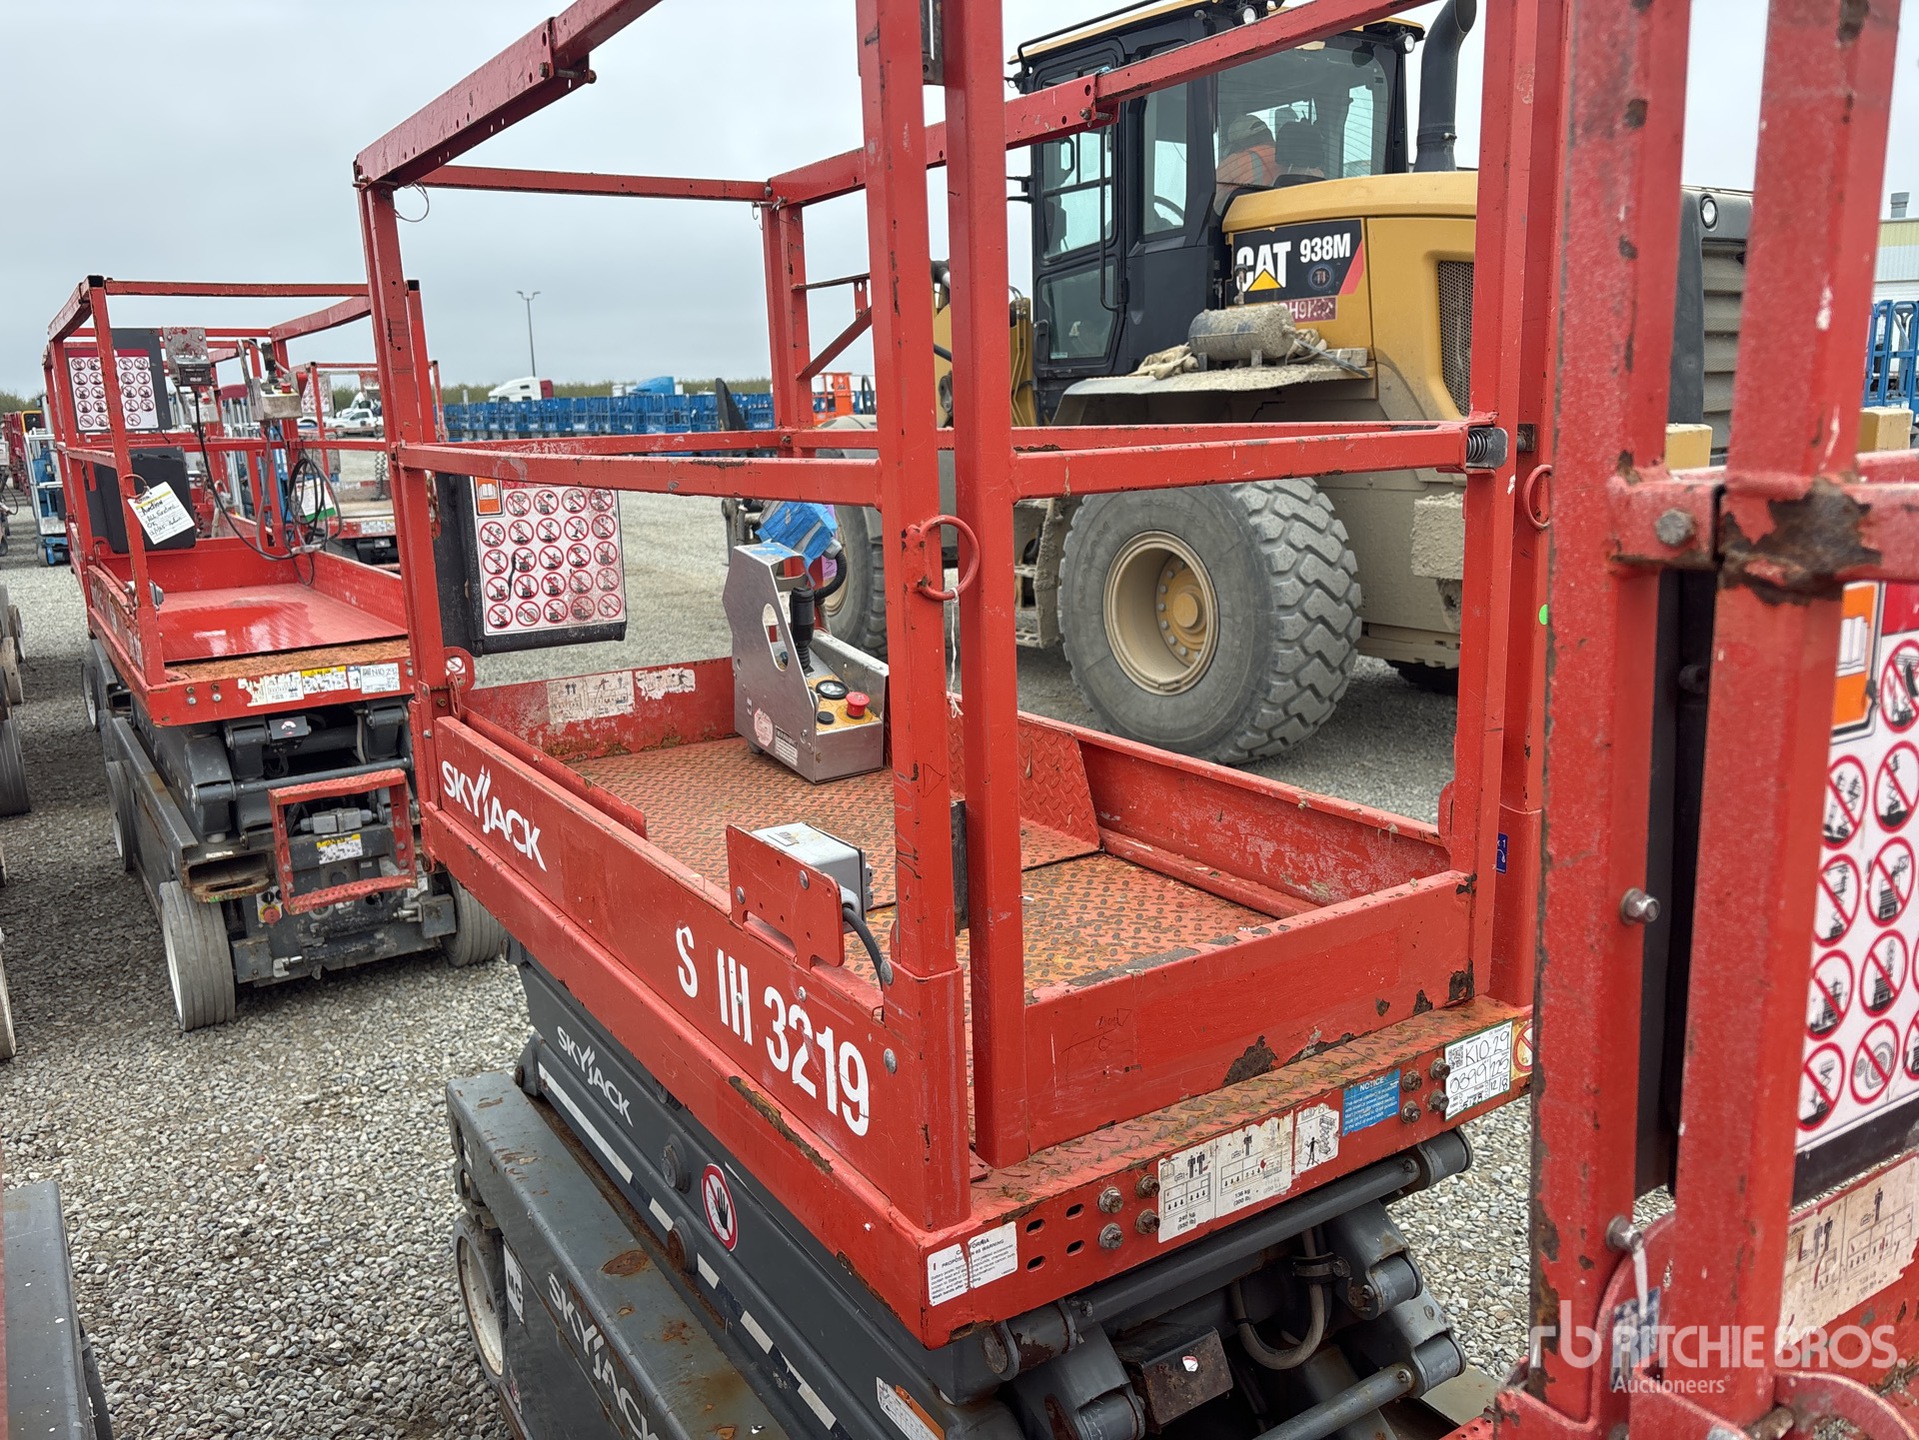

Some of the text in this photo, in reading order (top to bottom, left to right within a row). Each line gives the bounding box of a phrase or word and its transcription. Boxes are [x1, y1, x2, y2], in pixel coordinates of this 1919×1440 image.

[1236, 233, 1351, 292] CAT 938M
[442, 760, 547, 872] SKYJACK
[557, 1026, 633, 1127] SKYJACK
[676, 926, 698, 998] S
[764, 986, 869, 1136] 3219
[1359, 1075, 1385, 1091] NOTICE
